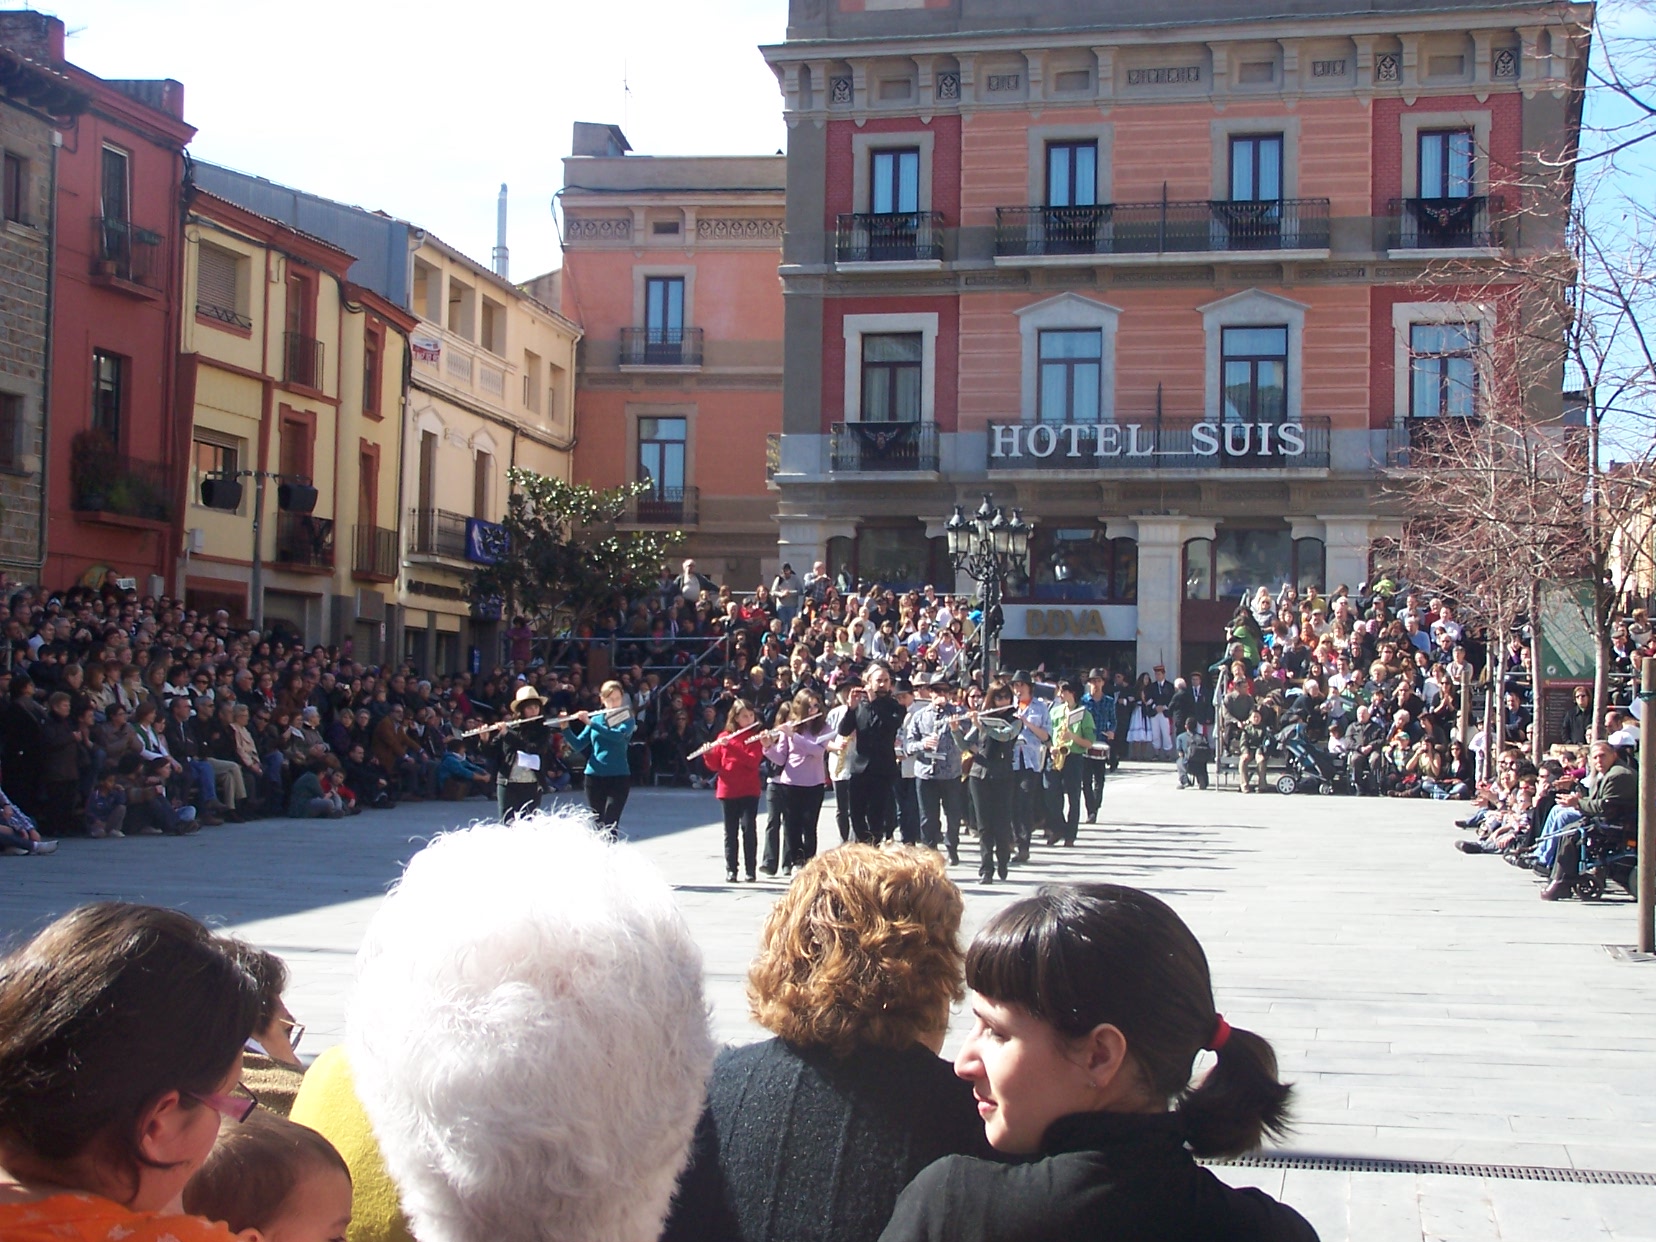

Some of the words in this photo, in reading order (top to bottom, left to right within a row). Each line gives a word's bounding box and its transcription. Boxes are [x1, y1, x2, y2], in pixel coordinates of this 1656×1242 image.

[992, 424, 1154, 457] HOTEL
[1191, 422, 1305, 456] SUIS
[1026, 609, 1106, 636] BBVA
